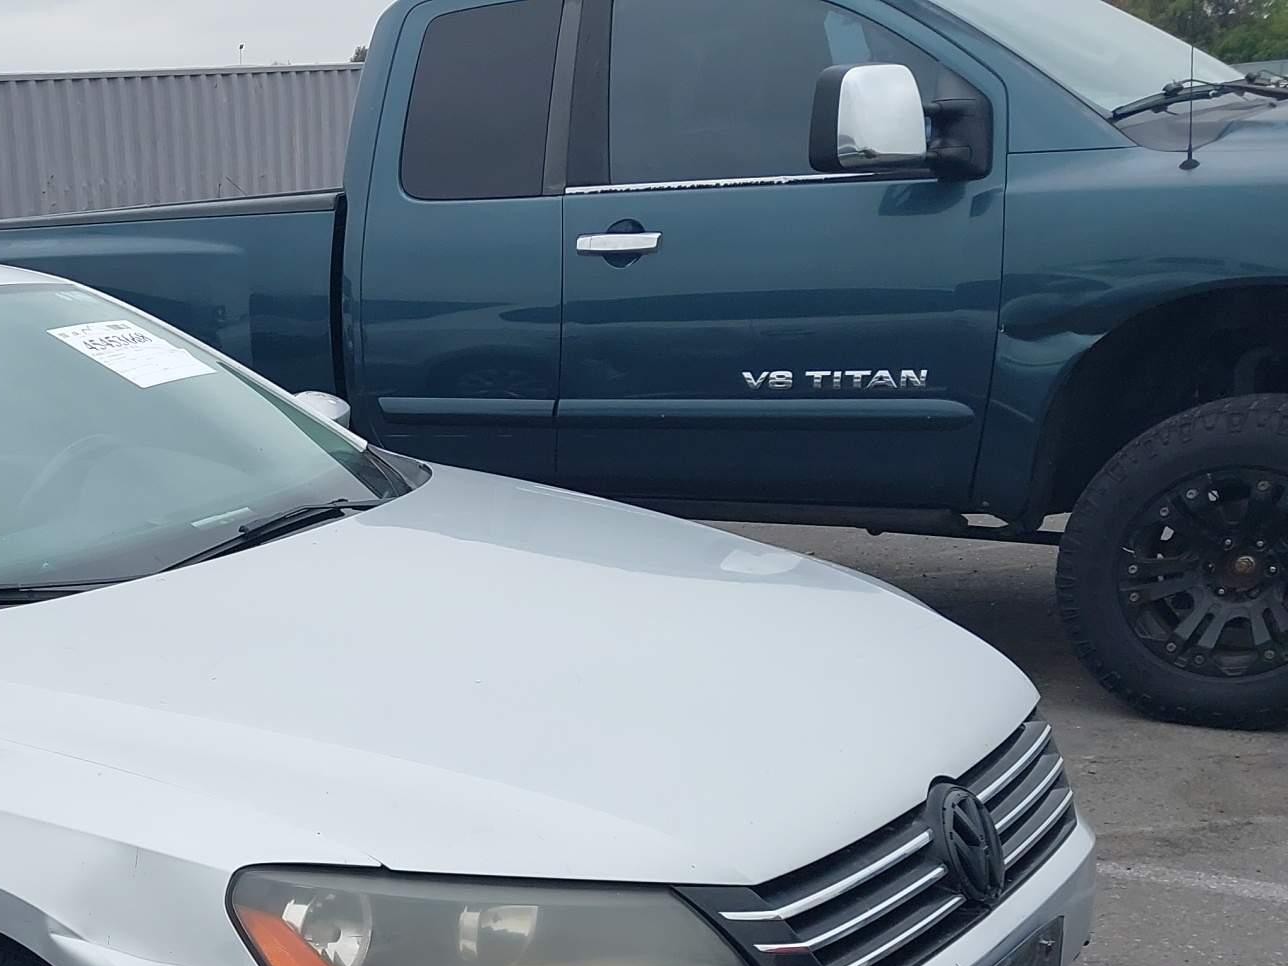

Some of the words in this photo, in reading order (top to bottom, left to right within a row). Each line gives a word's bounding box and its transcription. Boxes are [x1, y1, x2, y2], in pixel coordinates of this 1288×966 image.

[83, 332, 152, 350] 45453668
[742, 370, 793, 390] V8
[805, 369, 928, 390] TITAN
